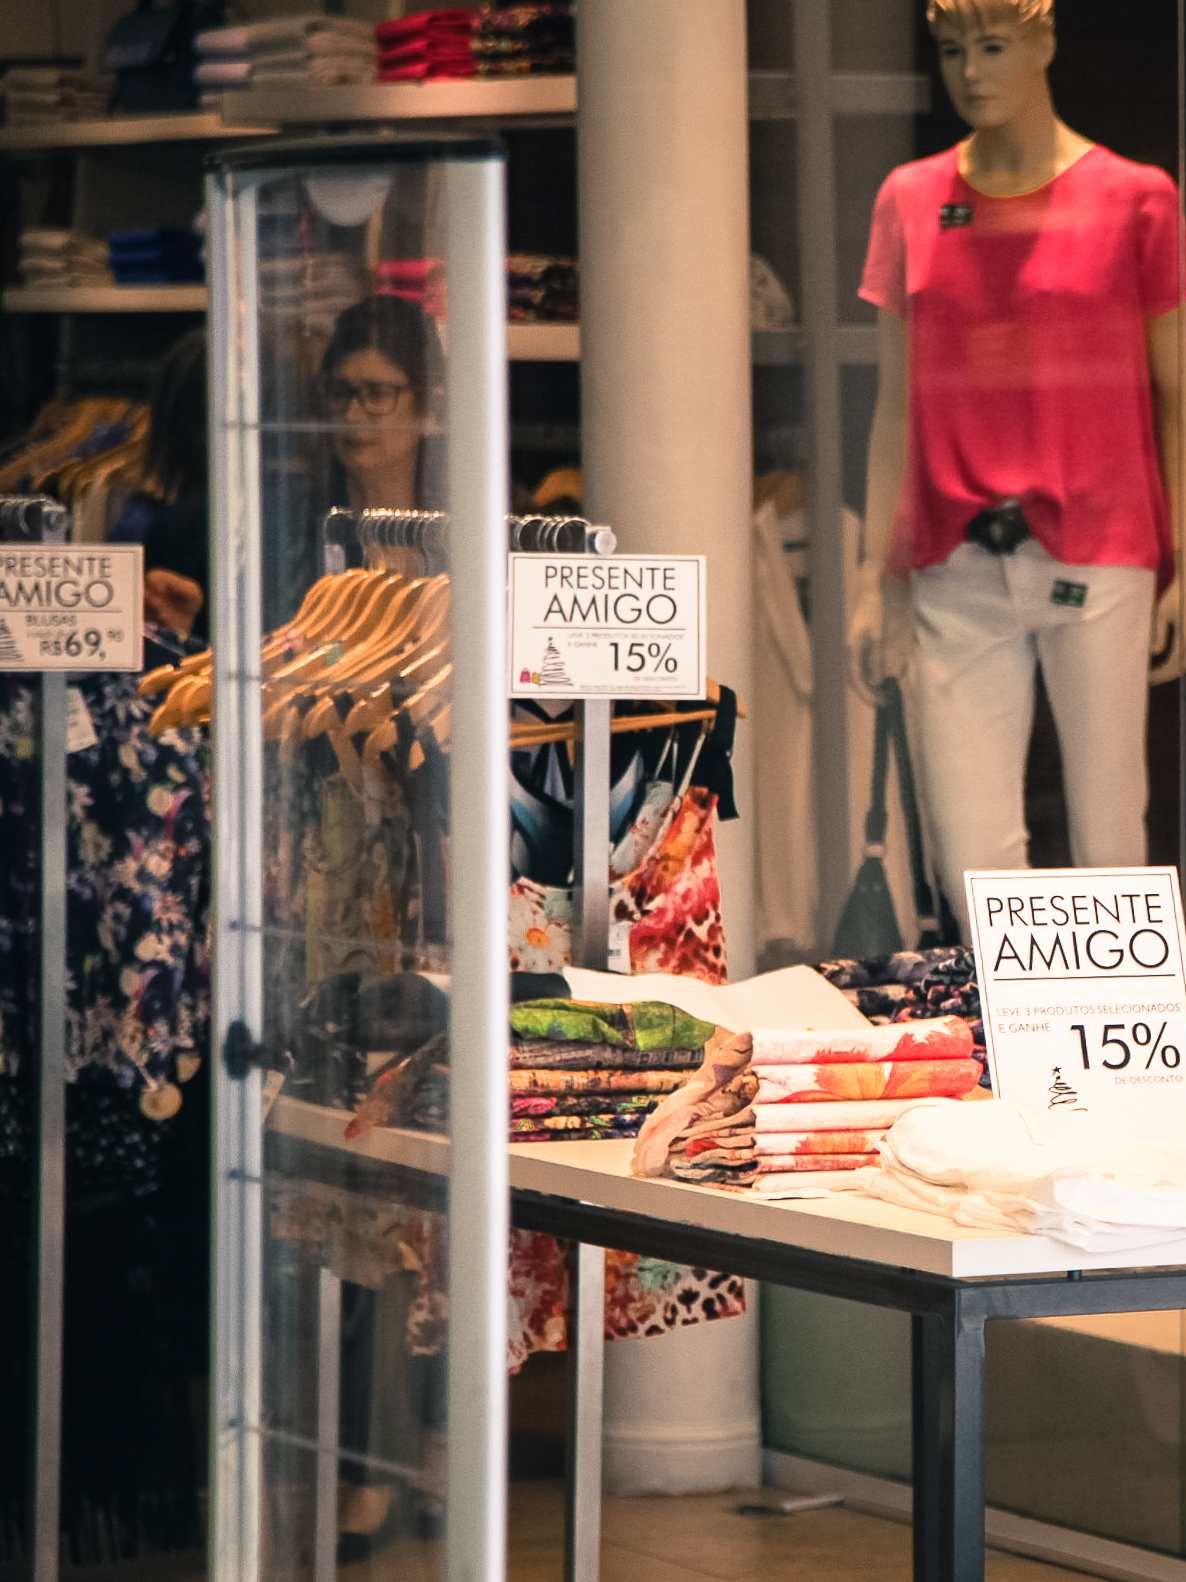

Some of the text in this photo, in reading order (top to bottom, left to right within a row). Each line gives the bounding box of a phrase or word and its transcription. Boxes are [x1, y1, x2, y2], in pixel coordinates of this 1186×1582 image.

[0, 556, 112, 578] RESENTE
[544, 565, 676, 591] PRESENTE
[543, 593, 677, 625] AMIGO
[608, 642, 678, 673] 15%
[986, 893, 1163, 927] PRESENTE
[993, 928, 1170, 972] AMIGO
[996, 1006, 1022, 1017] LEVE
[1026, 1006, 1031, 1016] 3
[1034, 1004, 1095, 1016] PRODUTOS
[998, 1022, 1052, 1033] E GANHE
[1070, 1021, 1181, 1070] 15%
[1114, 1075, 1127, 1085] DE
